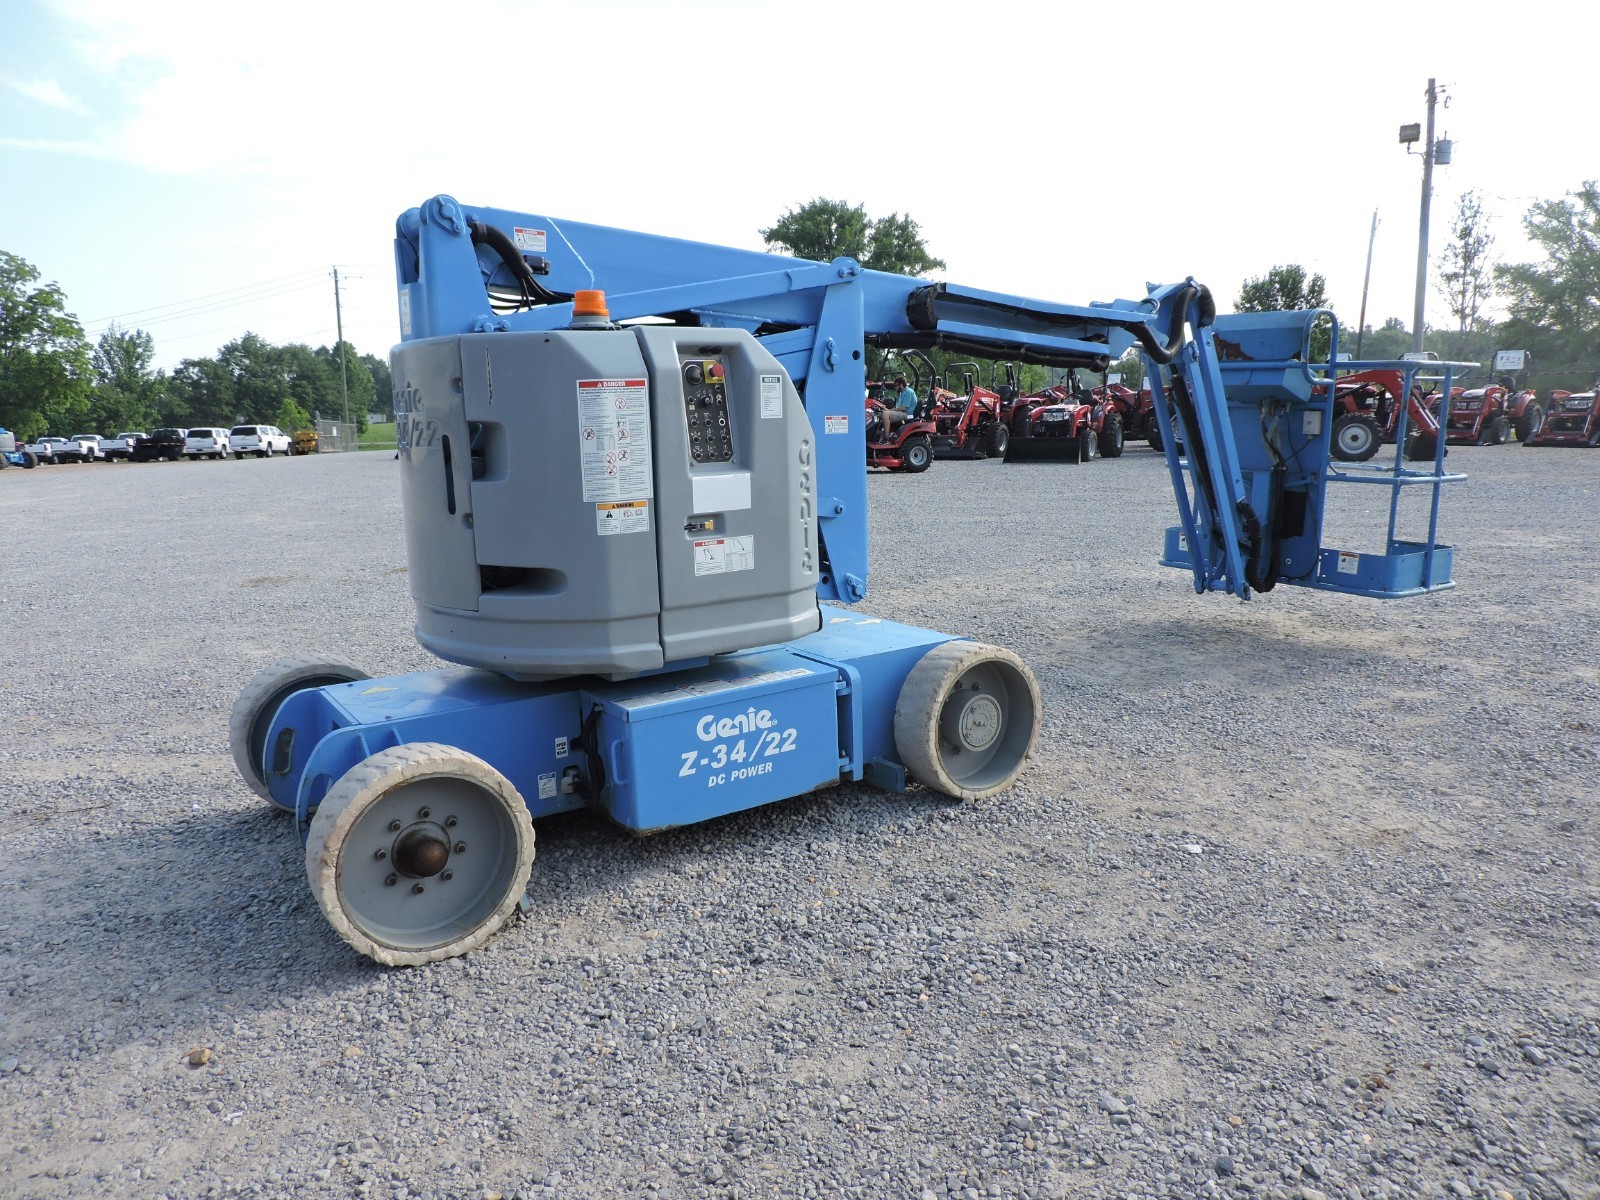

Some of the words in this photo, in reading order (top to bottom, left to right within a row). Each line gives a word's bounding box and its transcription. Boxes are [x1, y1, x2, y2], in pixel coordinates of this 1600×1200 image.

[696, 706, 772, 742] Genie
[678, 727, 798, 778] Z-34/22
[707, 773, 726, 788] DC
[730, 761, 773, 782] POWER
